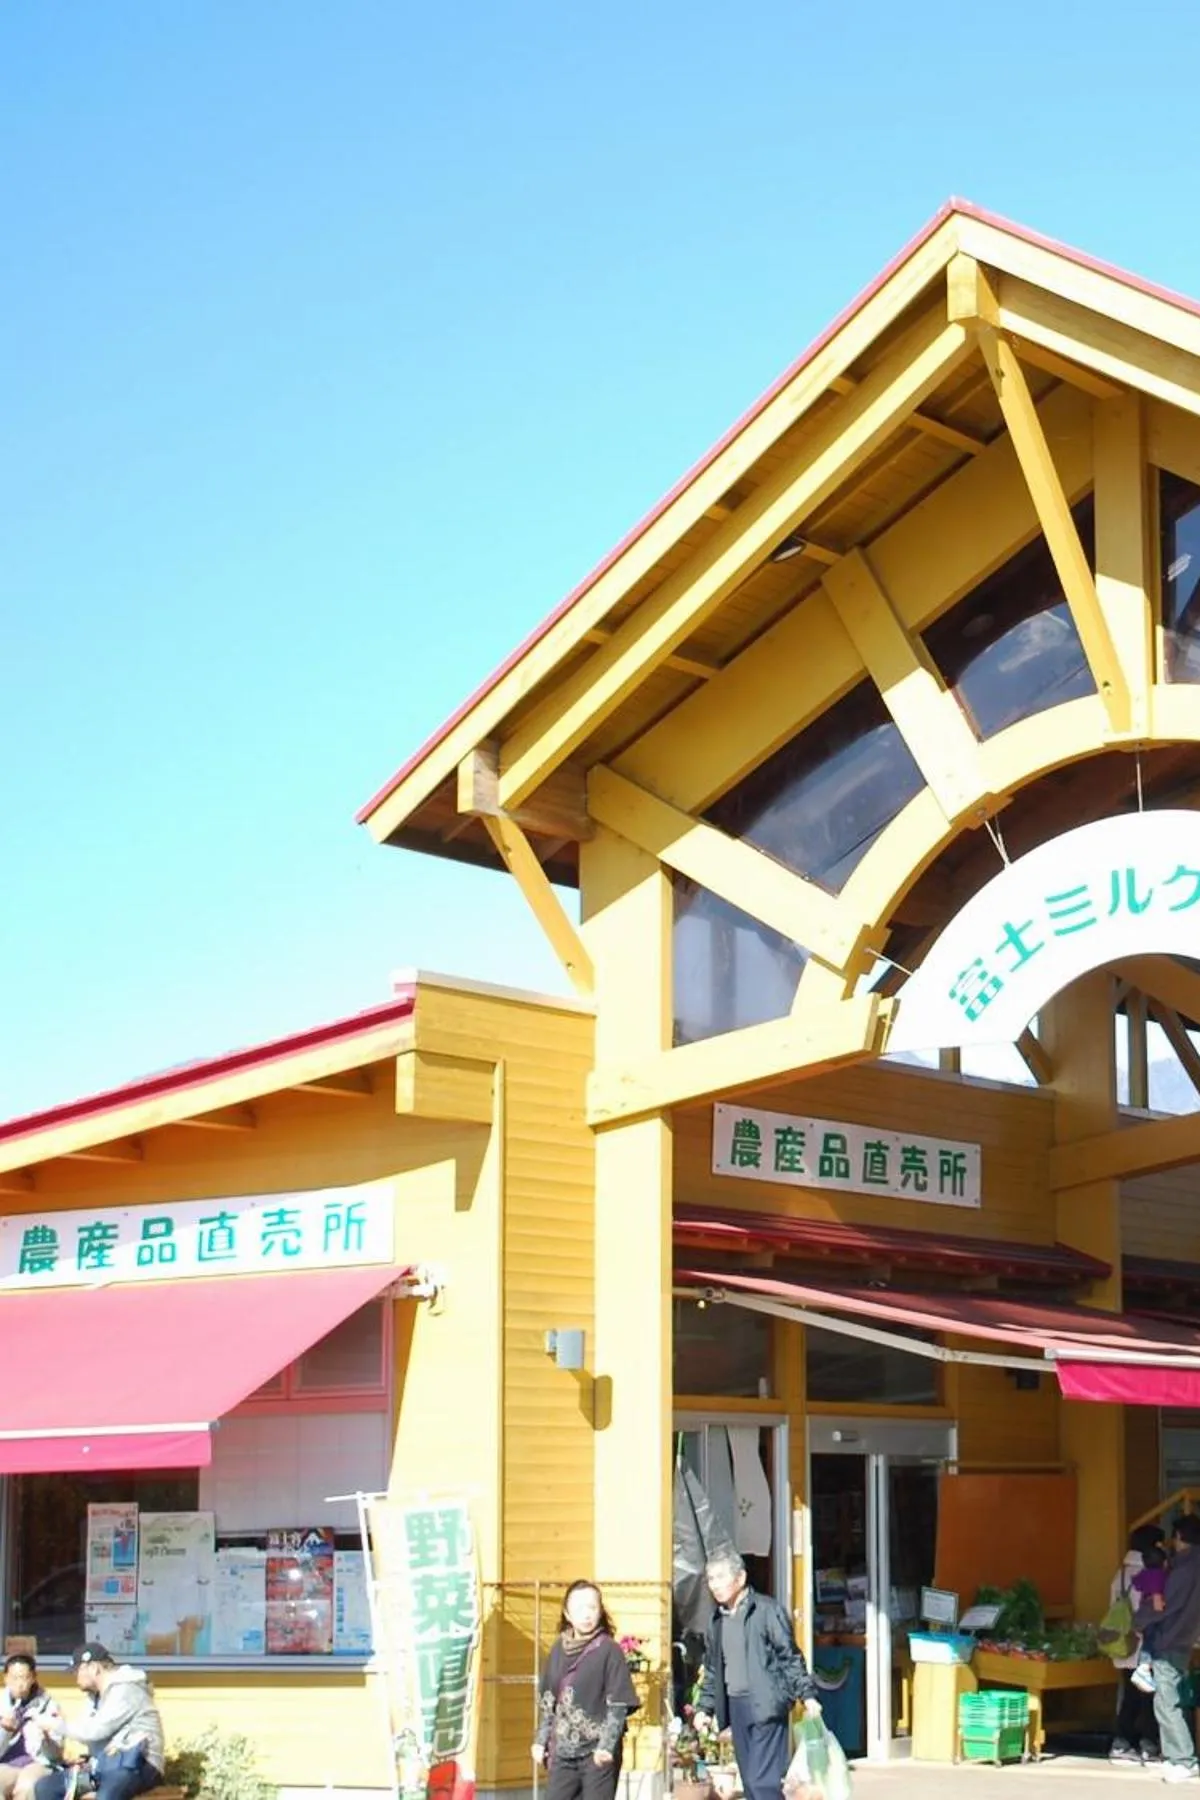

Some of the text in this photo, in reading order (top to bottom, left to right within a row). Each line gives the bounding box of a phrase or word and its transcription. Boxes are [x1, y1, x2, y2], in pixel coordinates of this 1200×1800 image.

[730, 1118, 967, 1197] 農産品直売所
[18, 1202, 366, 1274] 農産品直売所
